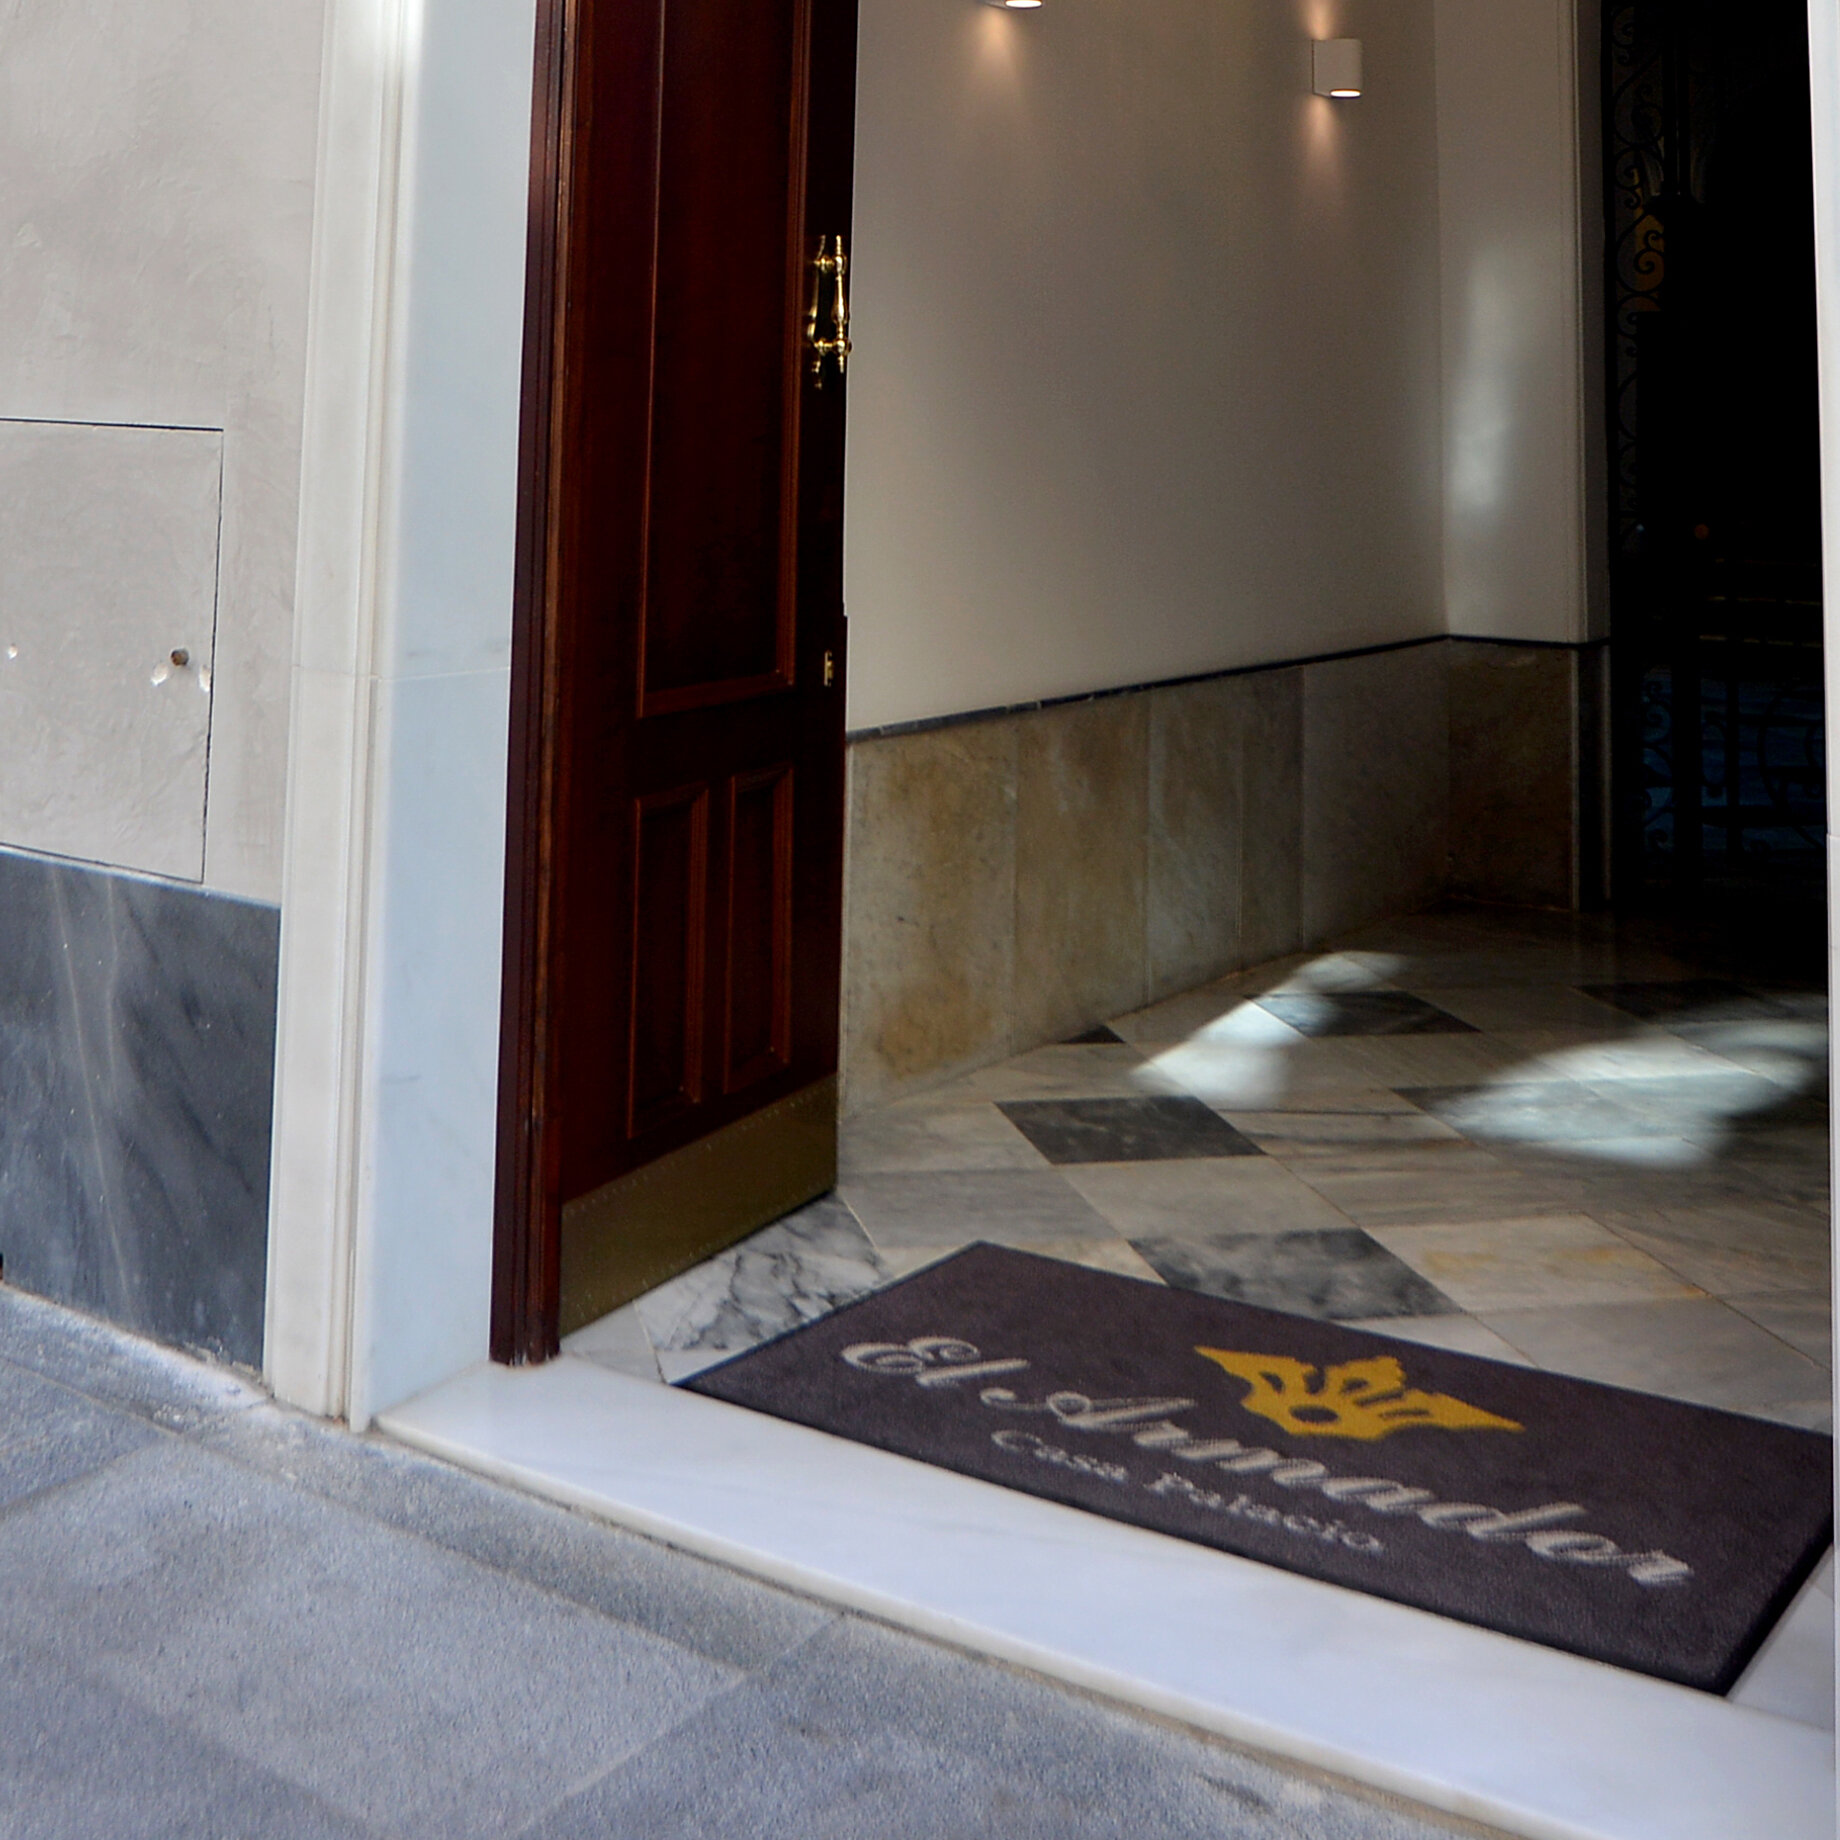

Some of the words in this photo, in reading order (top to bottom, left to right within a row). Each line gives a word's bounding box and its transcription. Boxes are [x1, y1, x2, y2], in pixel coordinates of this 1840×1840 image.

[843, 1335, 1028, 1388] El
[980, 1382, 1694, 1586] Armador
[991, 1428, 1125, 1486] Casa
[1146, 1470, 1387, 1557] Palacio
